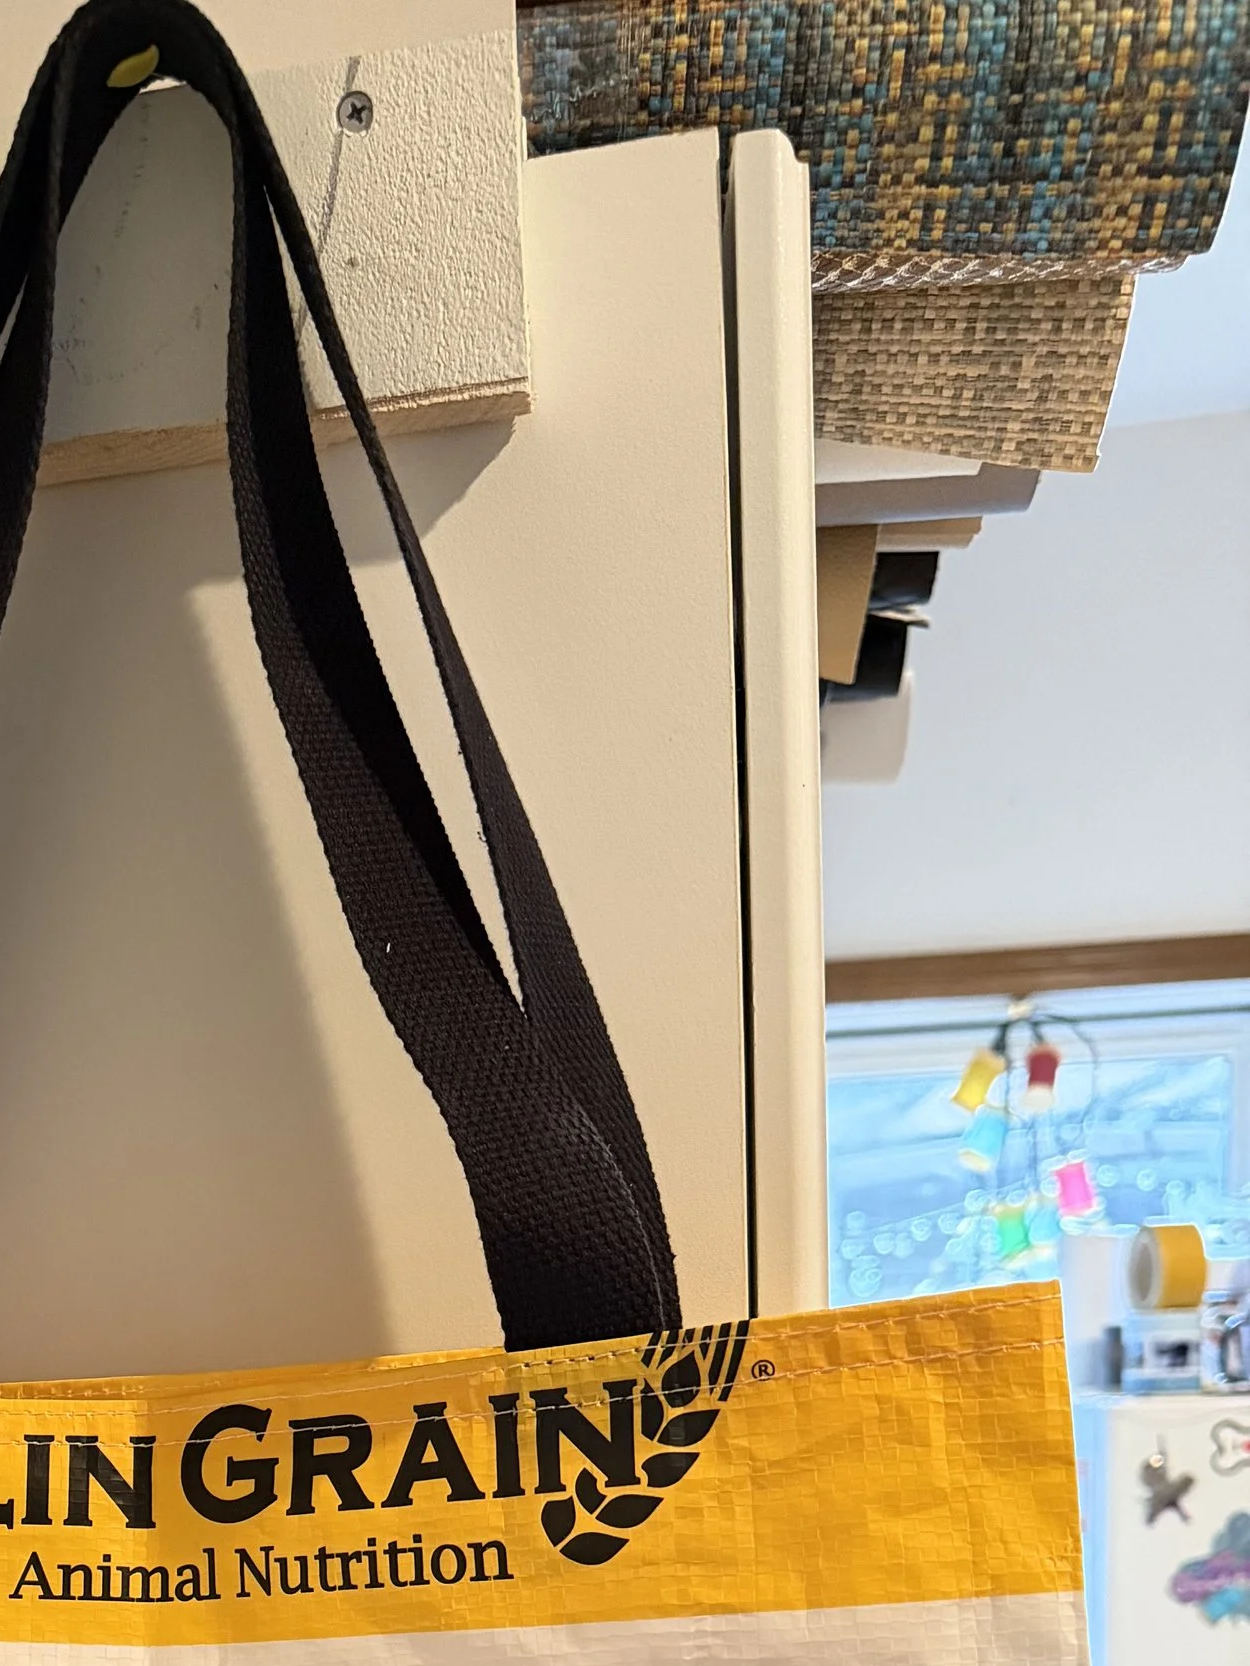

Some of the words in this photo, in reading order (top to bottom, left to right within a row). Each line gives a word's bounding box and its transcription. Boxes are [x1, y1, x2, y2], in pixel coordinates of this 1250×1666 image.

[180, 1379, 641, 1524] GRAIN
[8, 1547, 221, 1603] Animal
[234, 1533, 514, 1598] Nutrition
